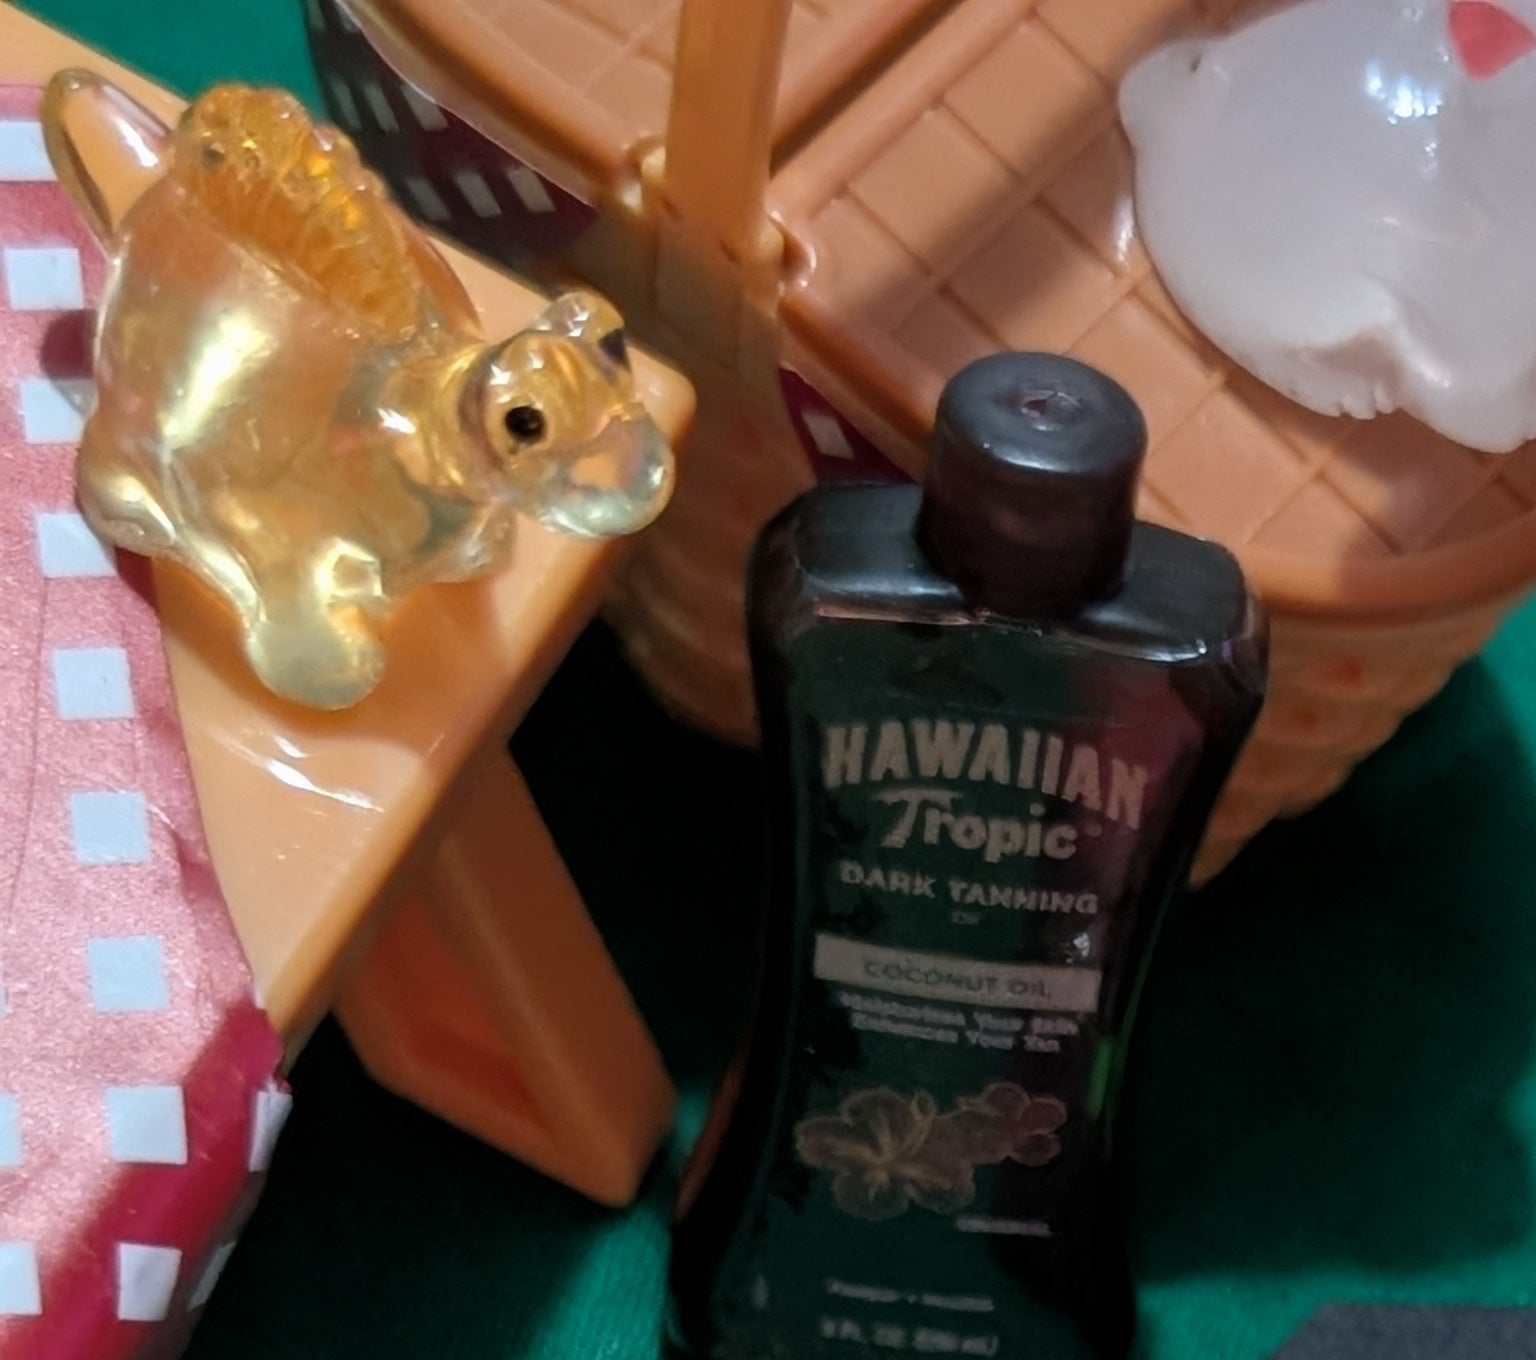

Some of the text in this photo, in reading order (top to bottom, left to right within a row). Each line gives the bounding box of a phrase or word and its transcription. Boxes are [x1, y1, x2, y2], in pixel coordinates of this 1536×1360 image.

[822, 717, 1150, 830] HAWAIIAN
[873, 785, 1078, 864] Tropic
[839, 858, 1100, 915] DARK TANNING
[865, 960, 997, 992] COCONUT
